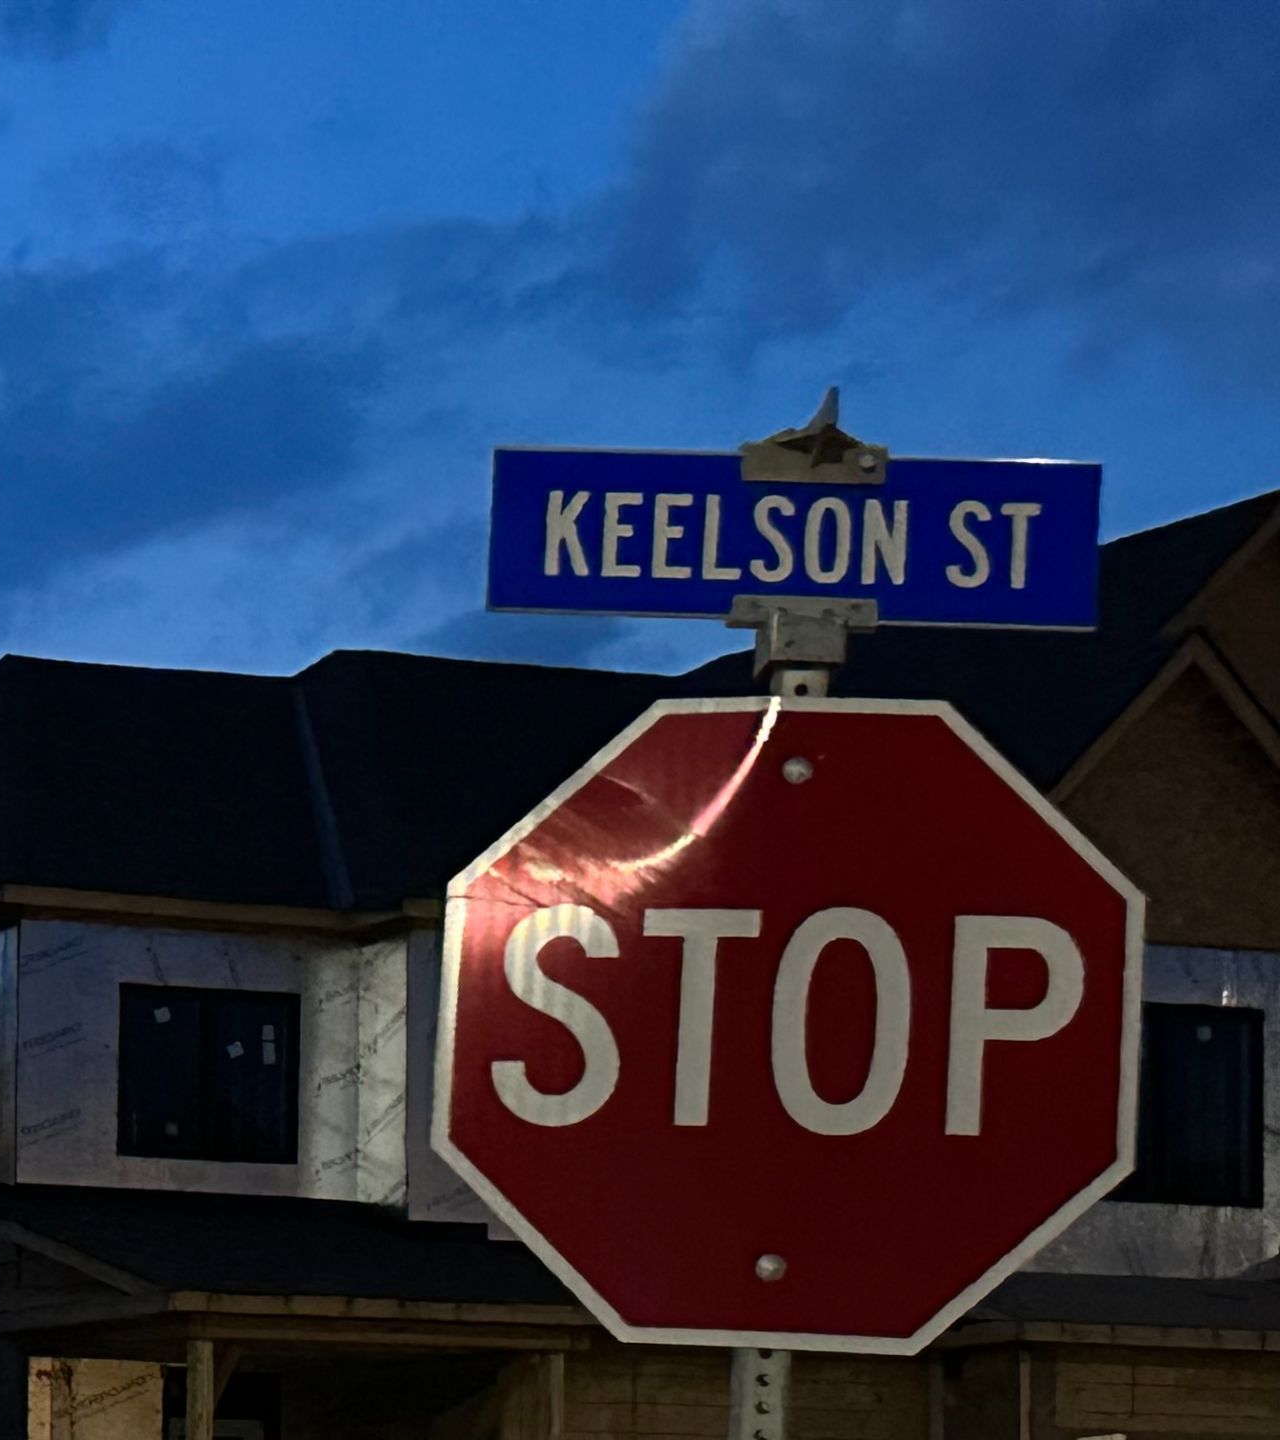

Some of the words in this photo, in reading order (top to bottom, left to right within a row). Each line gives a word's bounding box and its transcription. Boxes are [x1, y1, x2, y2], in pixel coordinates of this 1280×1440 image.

[543, 489, 910, 586] KEELSON
[945, 500, 1043, 590] ST
[490, 903, 1085, 1136] STOP
